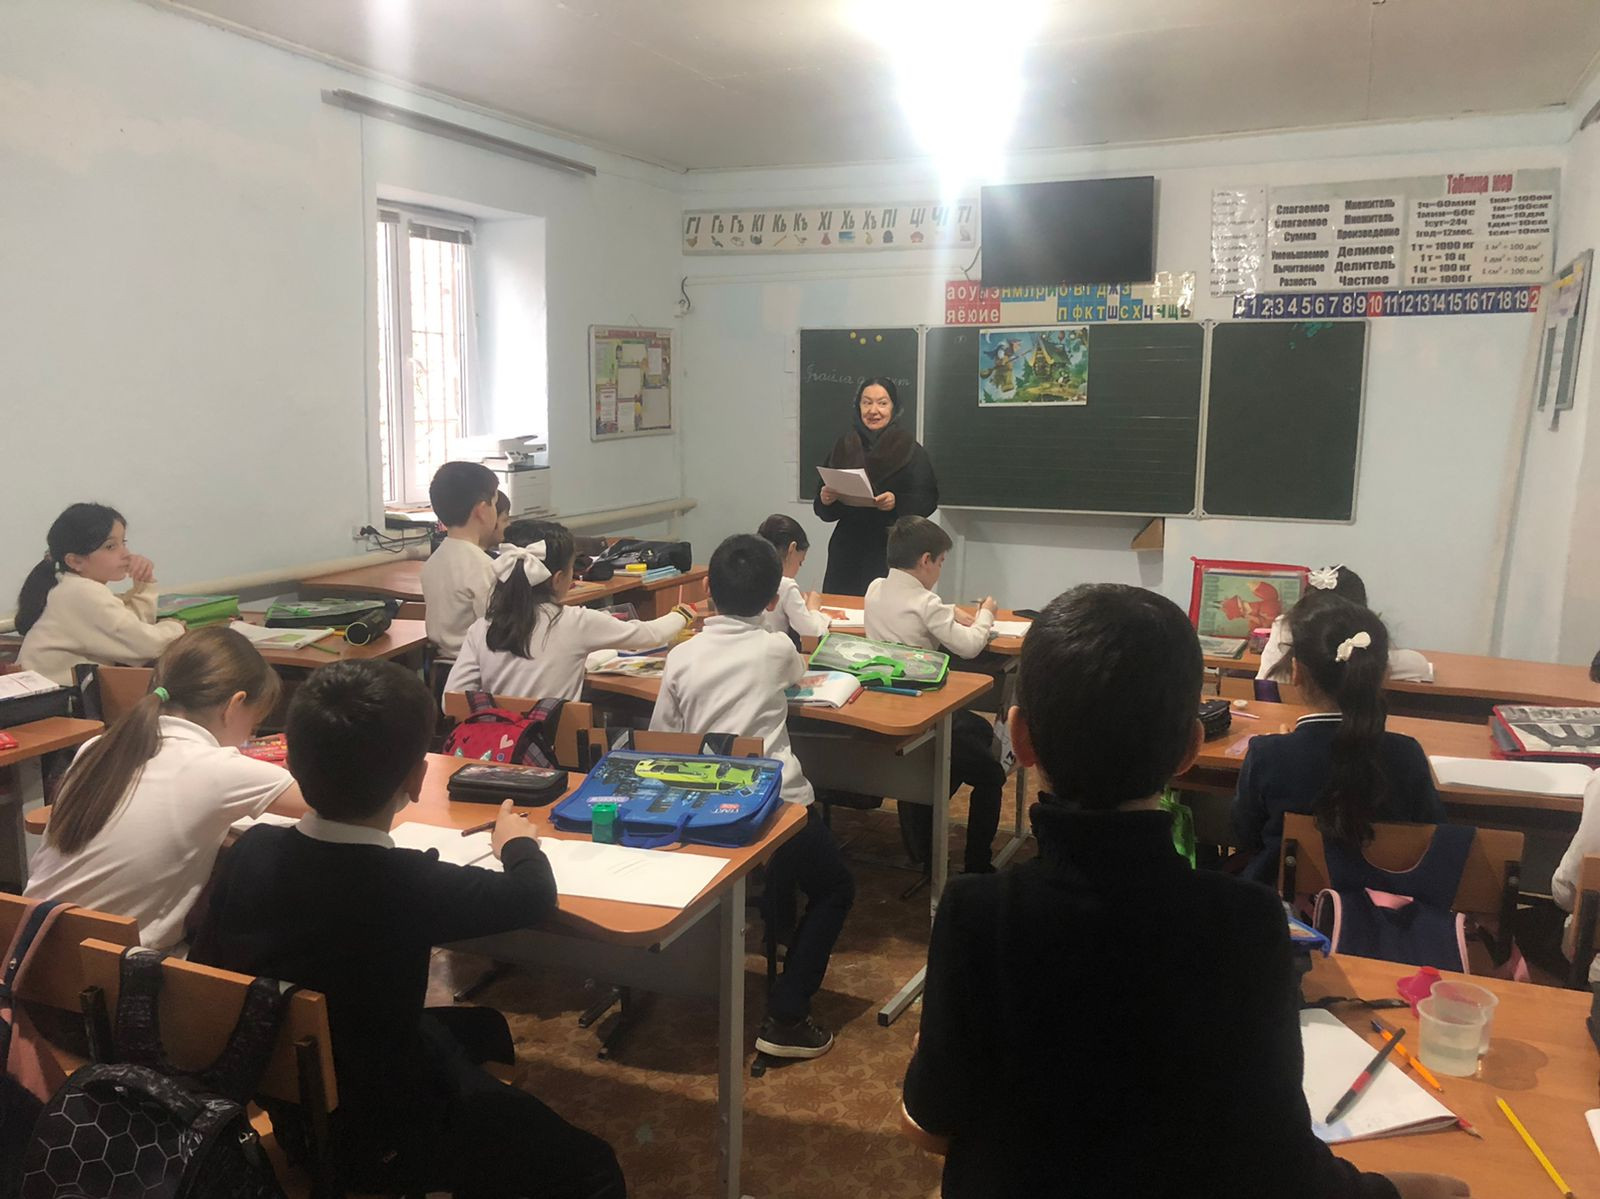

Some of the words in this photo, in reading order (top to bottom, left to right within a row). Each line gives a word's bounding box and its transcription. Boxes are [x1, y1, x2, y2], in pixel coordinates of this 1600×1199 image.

[1276, 203, 1330, 215] Слагаемое
[1345, 199, 1395, 210] Множитель
[1274, 217, 1328, 229] Слагаемое
[1344, 213, 1394, 225] Множитель
[1284, 232, 1317, 242] Сумма
[1336, 227, 1400, 240] Произведение
[1271, 250, 1329, 260] Уменьшаемое
[1337, 245, 1394, 258] Делимое
[1273, 264, 1325, 274] Вычитаемое
[1334, 261, 1396, 273] Делитель
[1279, 277, 1317, 287] Разность
[1339, 275, 1389, 286] Частное
[1249, 298, 1257, 315] 1
[1275, 298, 1284, 315] 3
[1287, 297, 1298, 315] 4
[1301, 297, 1311, 314] 5
[1315, 297, 1325, 314] 6
[1329, 296, 1338, 313] 7
[1342, 296, 1352, 314] 8
[1356, 295, 1366, 313] 9
[1370, 295, 1382, 313] 10
[1385, 295, 1398, 313] 11
[1401, 294, 1413, 313] 12
[1415, 294, 1429, 312] 13
[1431, 293, 1446, 312] 14
[1448, 293, 1462, 311] 15
[1464, 292, 1479, 311] 16
[1480, 292, 1495, 310] 17
[1497, 291, 1512, 309] 18
[1514, 290, 1528, 309] 19
